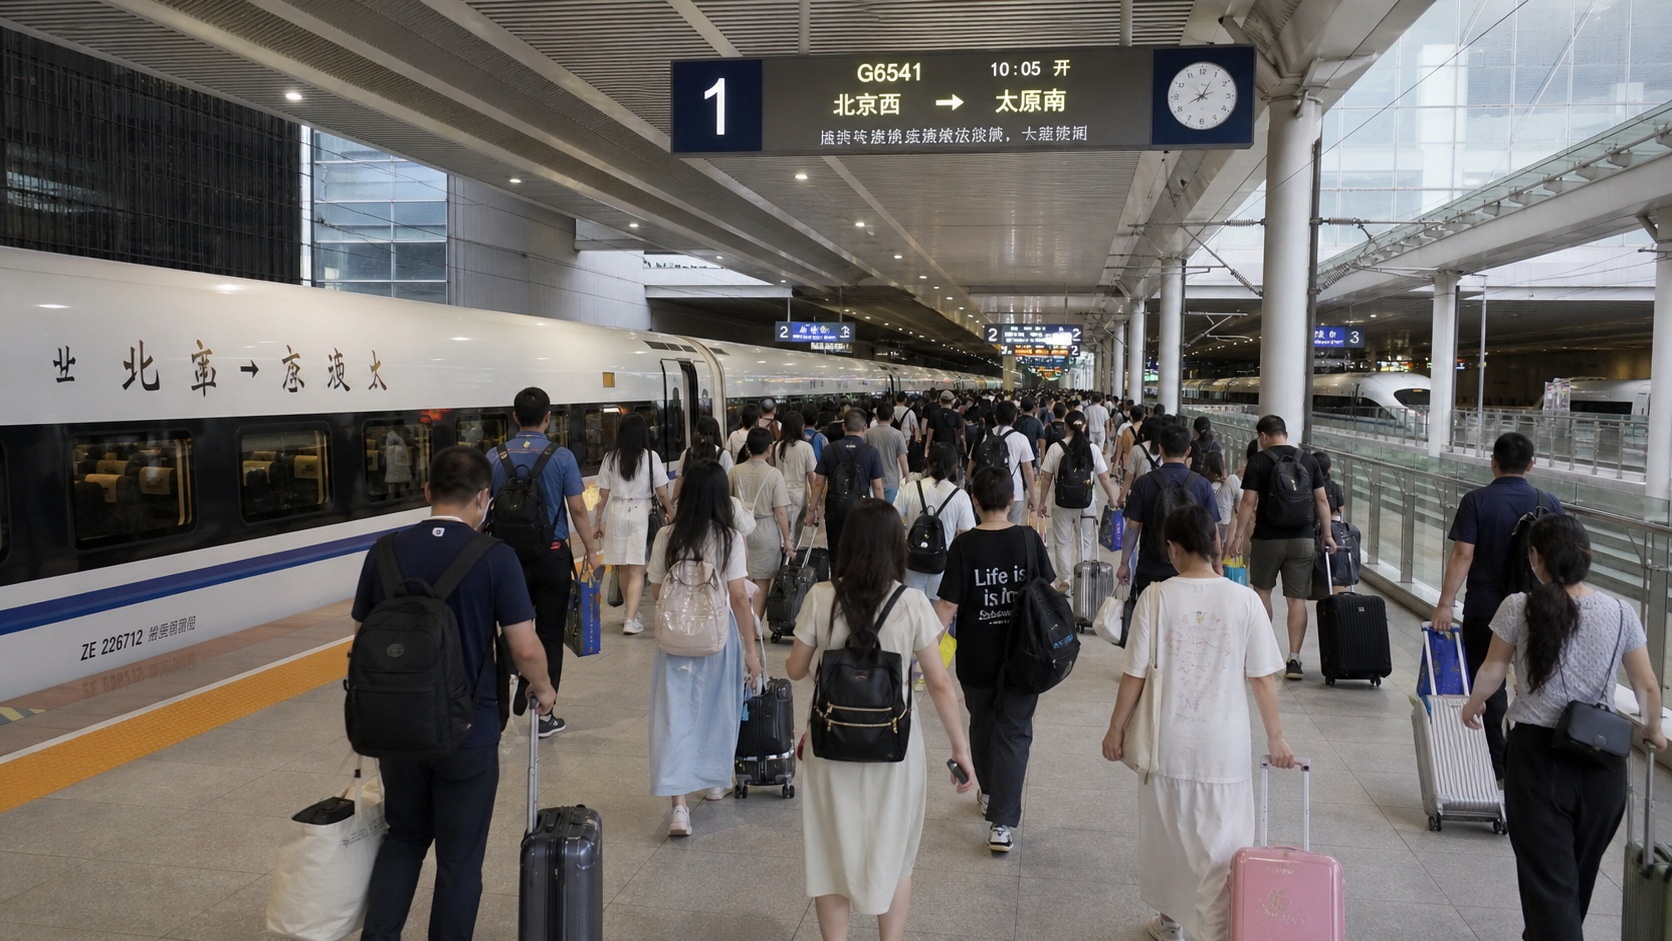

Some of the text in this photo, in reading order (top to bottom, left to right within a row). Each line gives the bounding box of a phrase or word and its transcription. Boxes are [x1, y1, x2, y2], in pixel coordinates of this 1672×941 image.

[858, 60, 1070, 82] G6541 10:05 开
[705, 78, 725, 135] 1
[833, 88, 1066, 116] 北京西 太原南
[779, 325, 789, 338] 2
[988, 327, 998, 342] 2
[1349, 330, 1360, 344] 3
[974, 565, 1026, 586] Life is
[80, 629, 143, 661] ZE 226712
